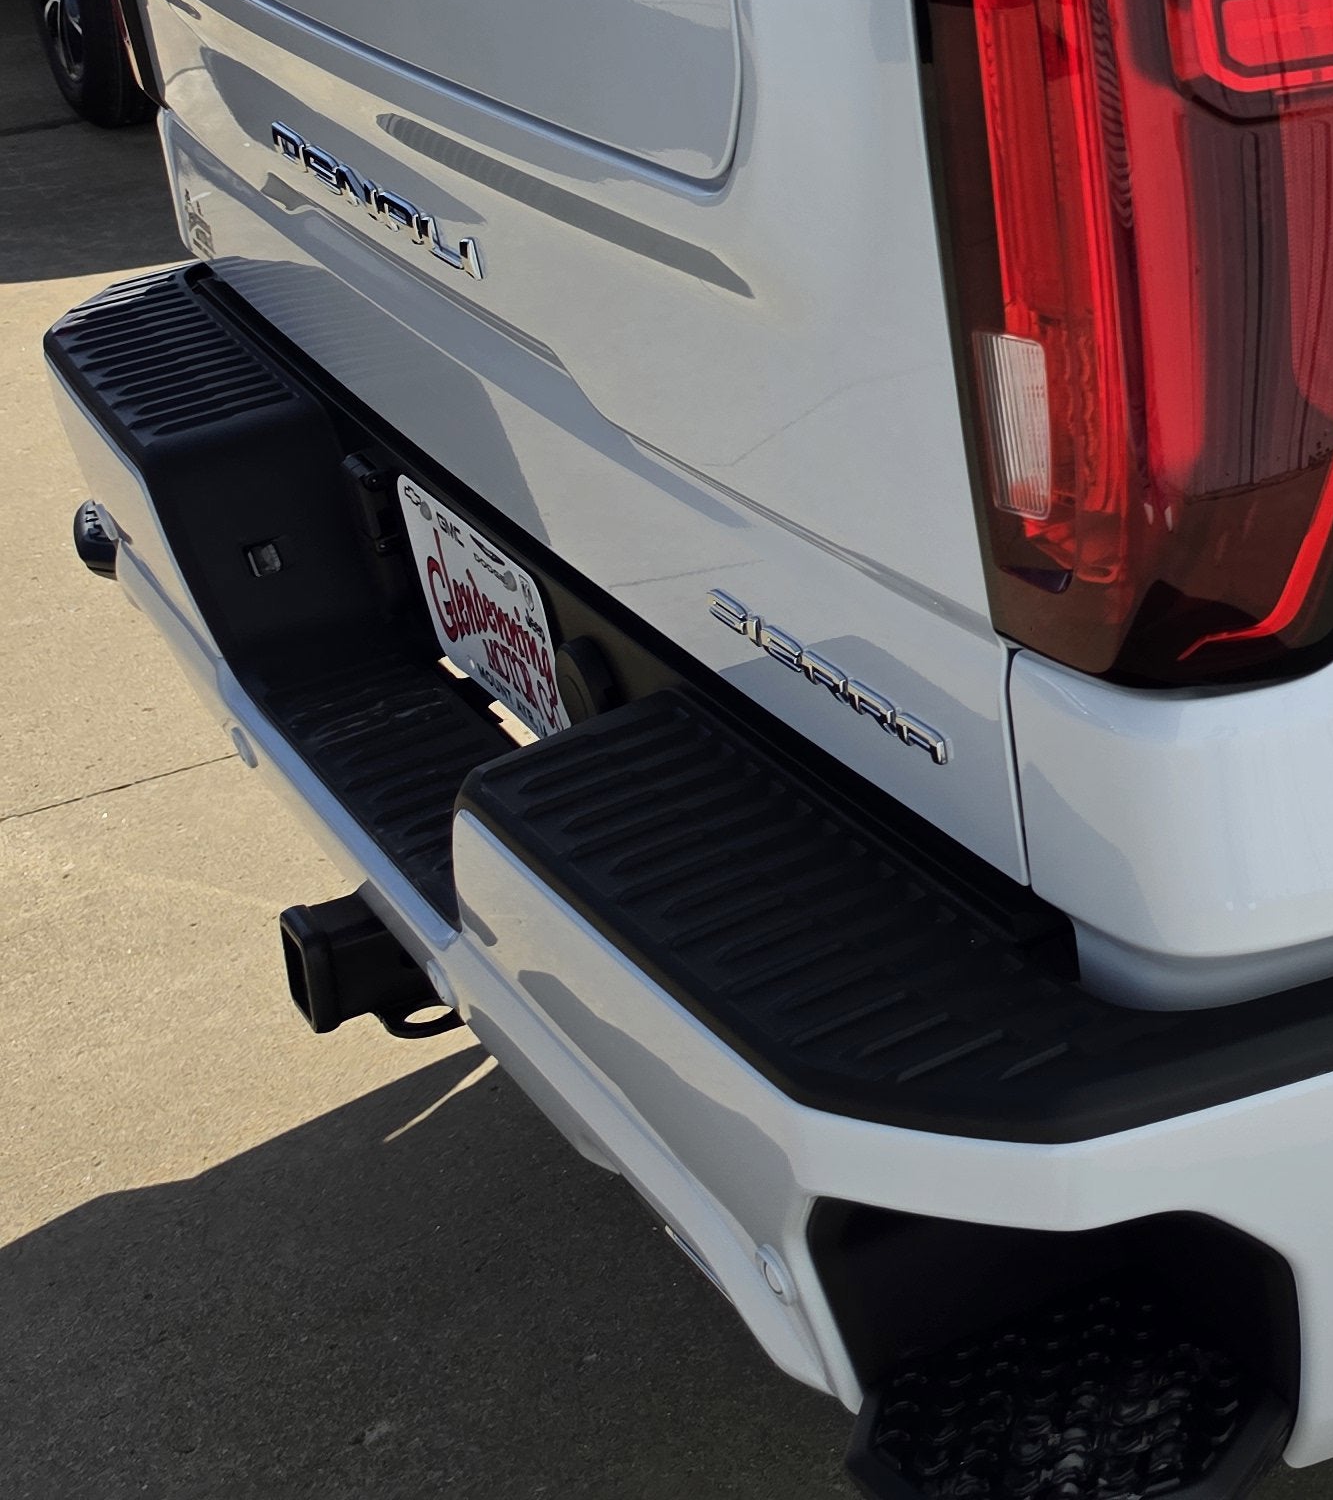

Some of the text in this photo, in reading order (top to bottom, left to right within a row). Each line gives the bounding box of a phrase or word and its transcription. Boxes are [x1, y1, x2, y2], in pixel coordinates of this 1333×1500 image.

[270, 120, 484, 281] DENALI
[435, 511, 466, 549] GMC
[426, 526, 558, 708] Glendenning
[482, 638, 544, 720] MOTOR
[706, 588, 949, 766] SIERRA
